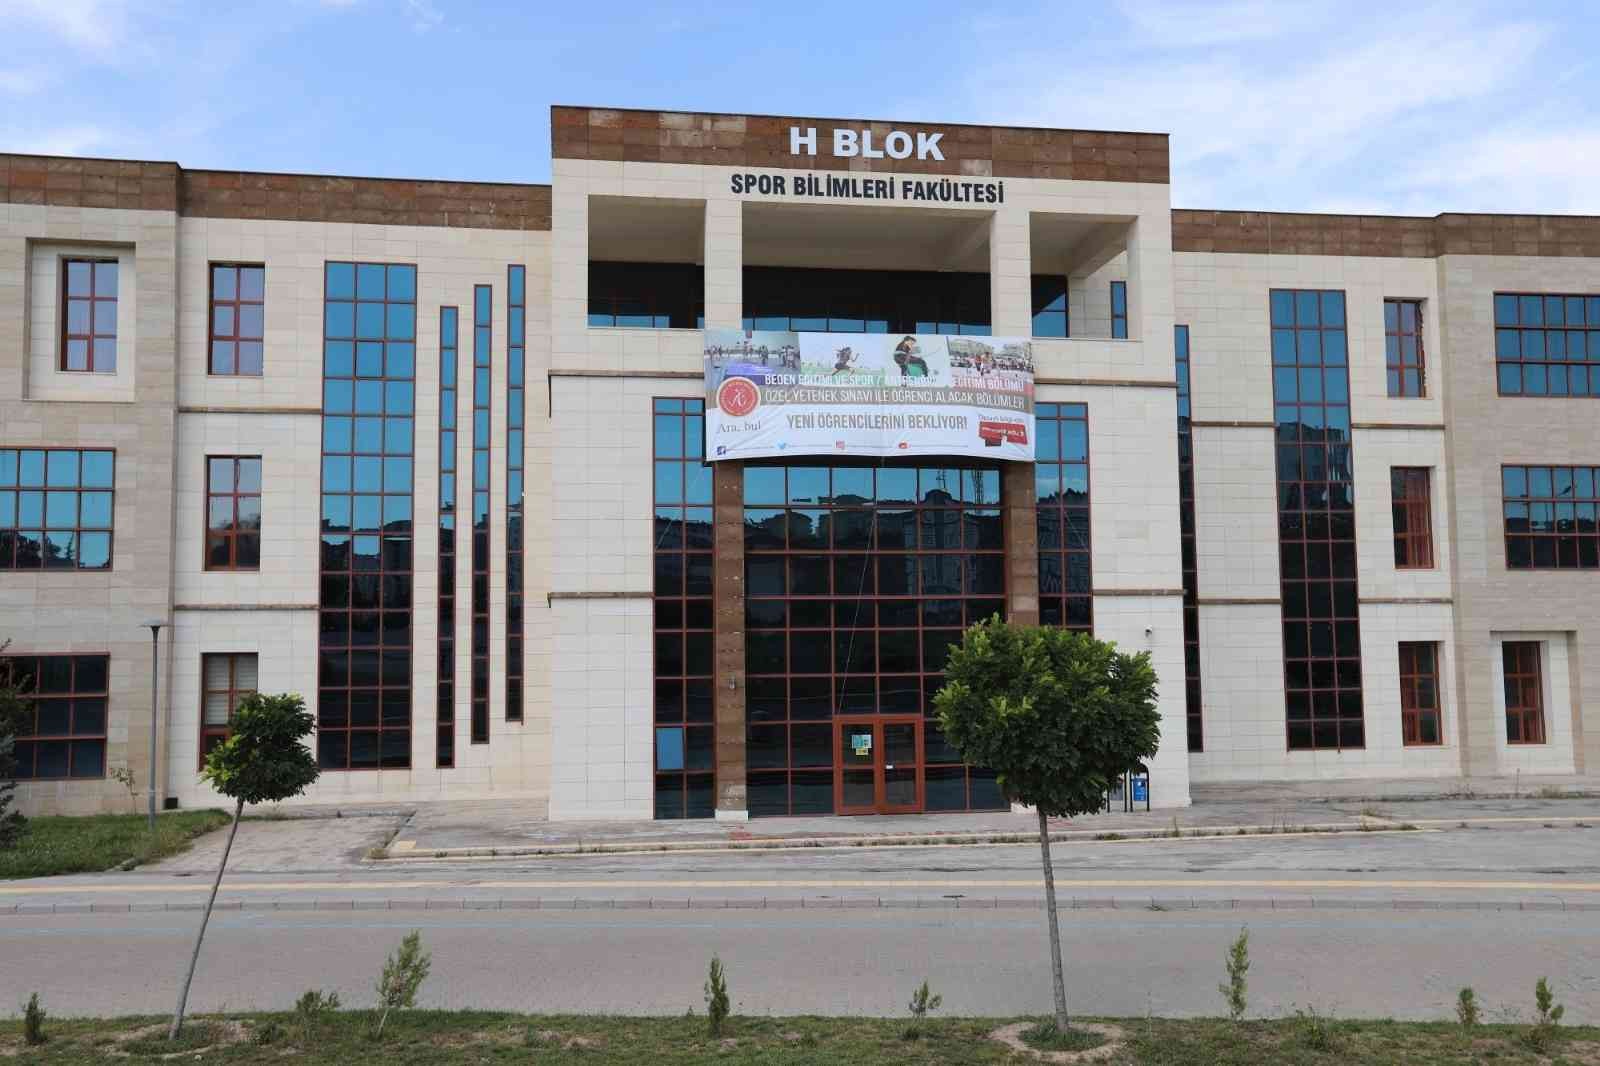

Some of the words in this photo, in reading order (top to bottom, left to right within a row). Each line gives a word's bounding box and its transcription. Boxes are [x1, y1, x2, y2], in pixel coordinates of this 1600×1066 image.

[789, 126, 818, 156] H
[832, 128, 946, 162] BLOK
[731, 173, 786, 196] SPOR
[794, 172, 895, 199] BİLİMLERİ
[902, 178, 1004, 204] FAKÜLTESİ
[786, 412, 814, 429] YENİ
